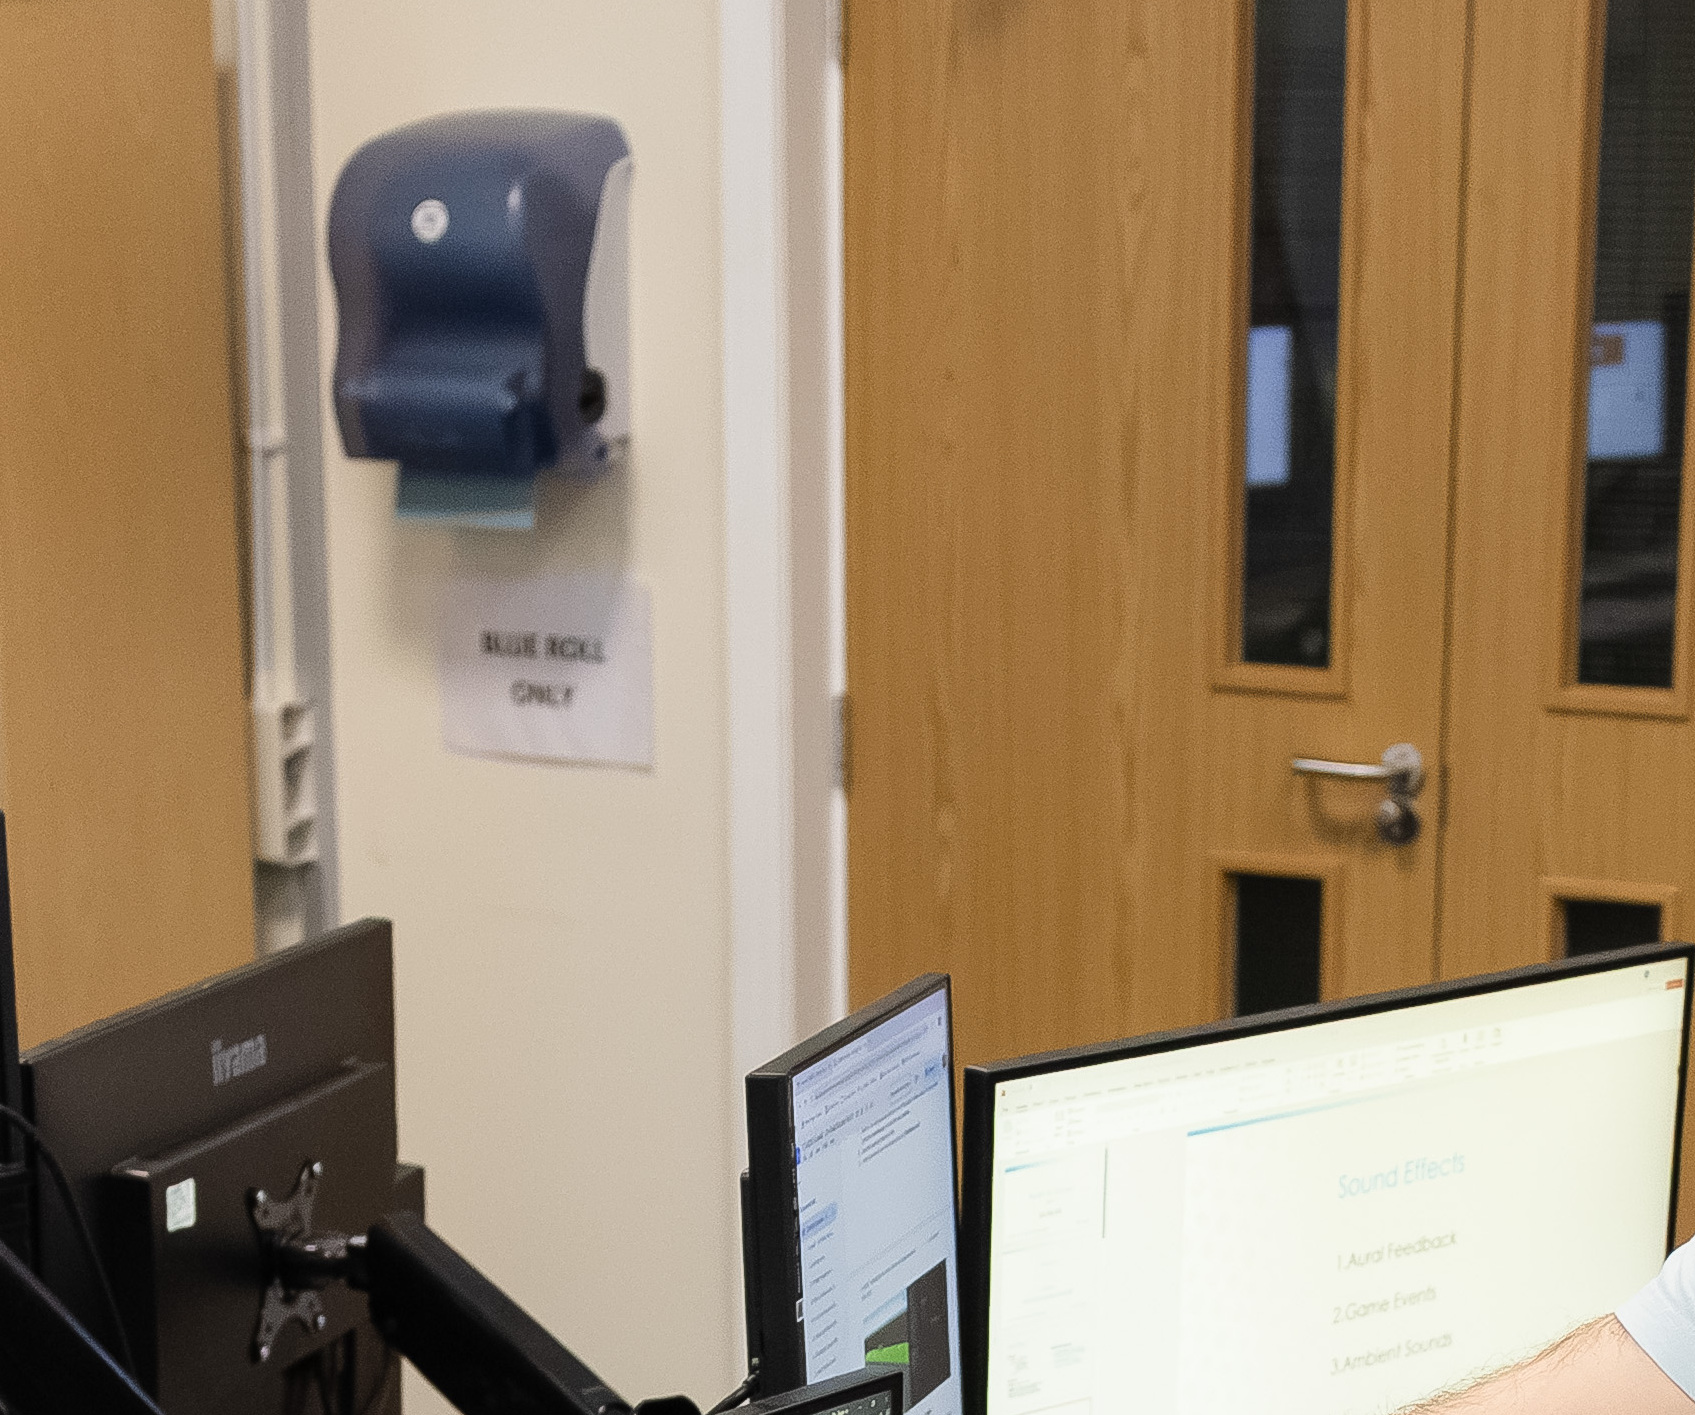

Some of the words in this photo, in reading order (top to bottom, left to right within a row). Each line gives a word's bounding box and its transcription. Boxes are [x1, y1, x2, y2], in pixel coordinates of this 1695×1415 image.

[481, 631, 536, 658] BLUE
[545, 633, 605, 664] ROLL
[510, 678, 575, 708] ONLY
[1337, 1166, 1398, 1199] Sound
[1404, 1152, 1465, 1185] Effects
[1387, 1231, 1458, 1260] Feedback
[1393, 1285, 1438, 1310] Events
[1405, 1331, 1454, 1358] Sounds
